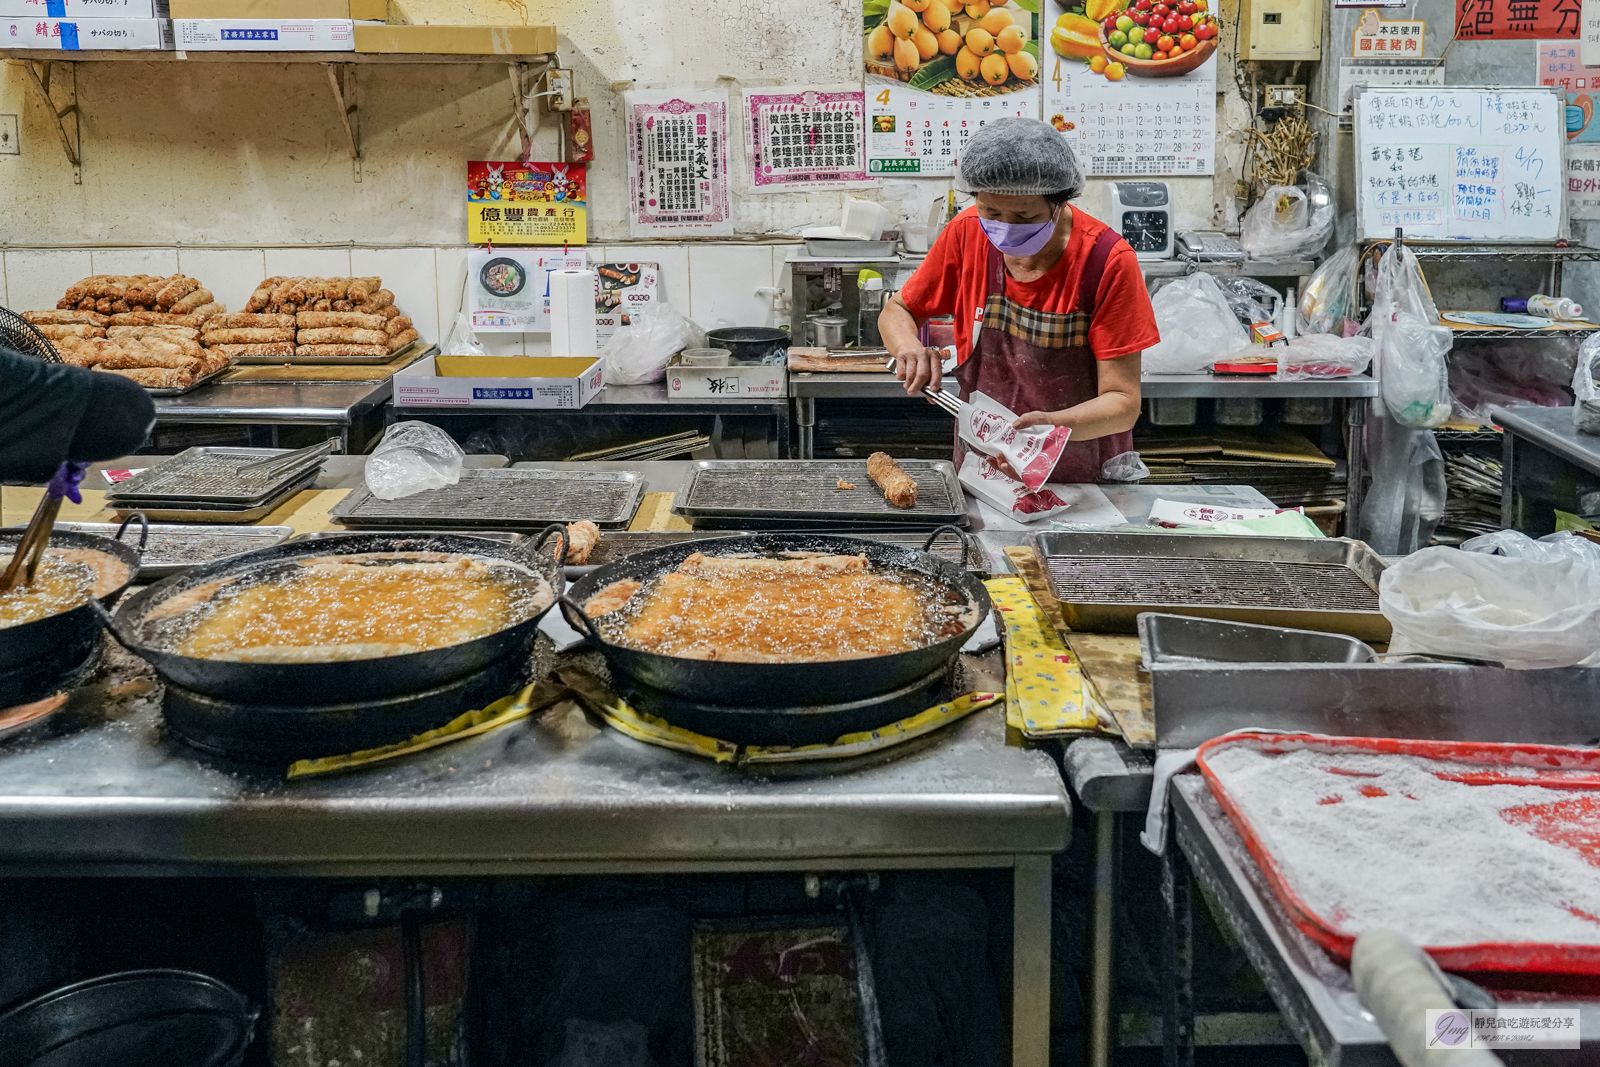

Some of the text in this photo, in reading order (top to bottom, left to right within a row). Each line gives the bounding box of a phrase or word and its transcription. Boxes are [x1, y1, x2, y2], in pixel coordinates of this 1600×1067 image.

[1380, 26, 1420, 35] 本店使用
[1360, 38, 1417, 51] 國產豬肉
[1540, 48, 1576, 58] 一兆二兆
[1051, 56, 1063, 92] 4
[1549, 62, 1576, 72] 比不上
[876, 89, 891, 105] 4
[1080, 102, 1200, 112] 2 3 4 5 6 7 8
[1080, 115, 1201, 126] 9 10 11 12 13 14 15
[770, 114, 782, 168] 做人要修養
[780, 114, 792, 168] 感情要培養
[790, 113, 803, 167] 生病要調養
[823, 112, 834, 166] 飲食要營養
[834, 111, 845, 167] 身體要保養
[844, 111, 856, 166] 父母要奉養
[1079, 129, 1201, 140] 16 17 18 19 20 21 22
[1097, 144, 1106, 152] 24
[1116, 144, 1125, 152] 25
[1135, 143, 1144, 152] 26
[1154, 143, 1162, 152] 27
[1173, 143, 1182, 152] 28
[1192, 142, 1201, 152] 29
[1515, 147, 1544, 180] 4/17
[1514, 182, 1552, 200] 星期一
[1568, 178, 1600, 192] 迎外
[1378, 191, 1439, 205] 不是本店的
[1510, 199, 1552, 218] 休息一天
